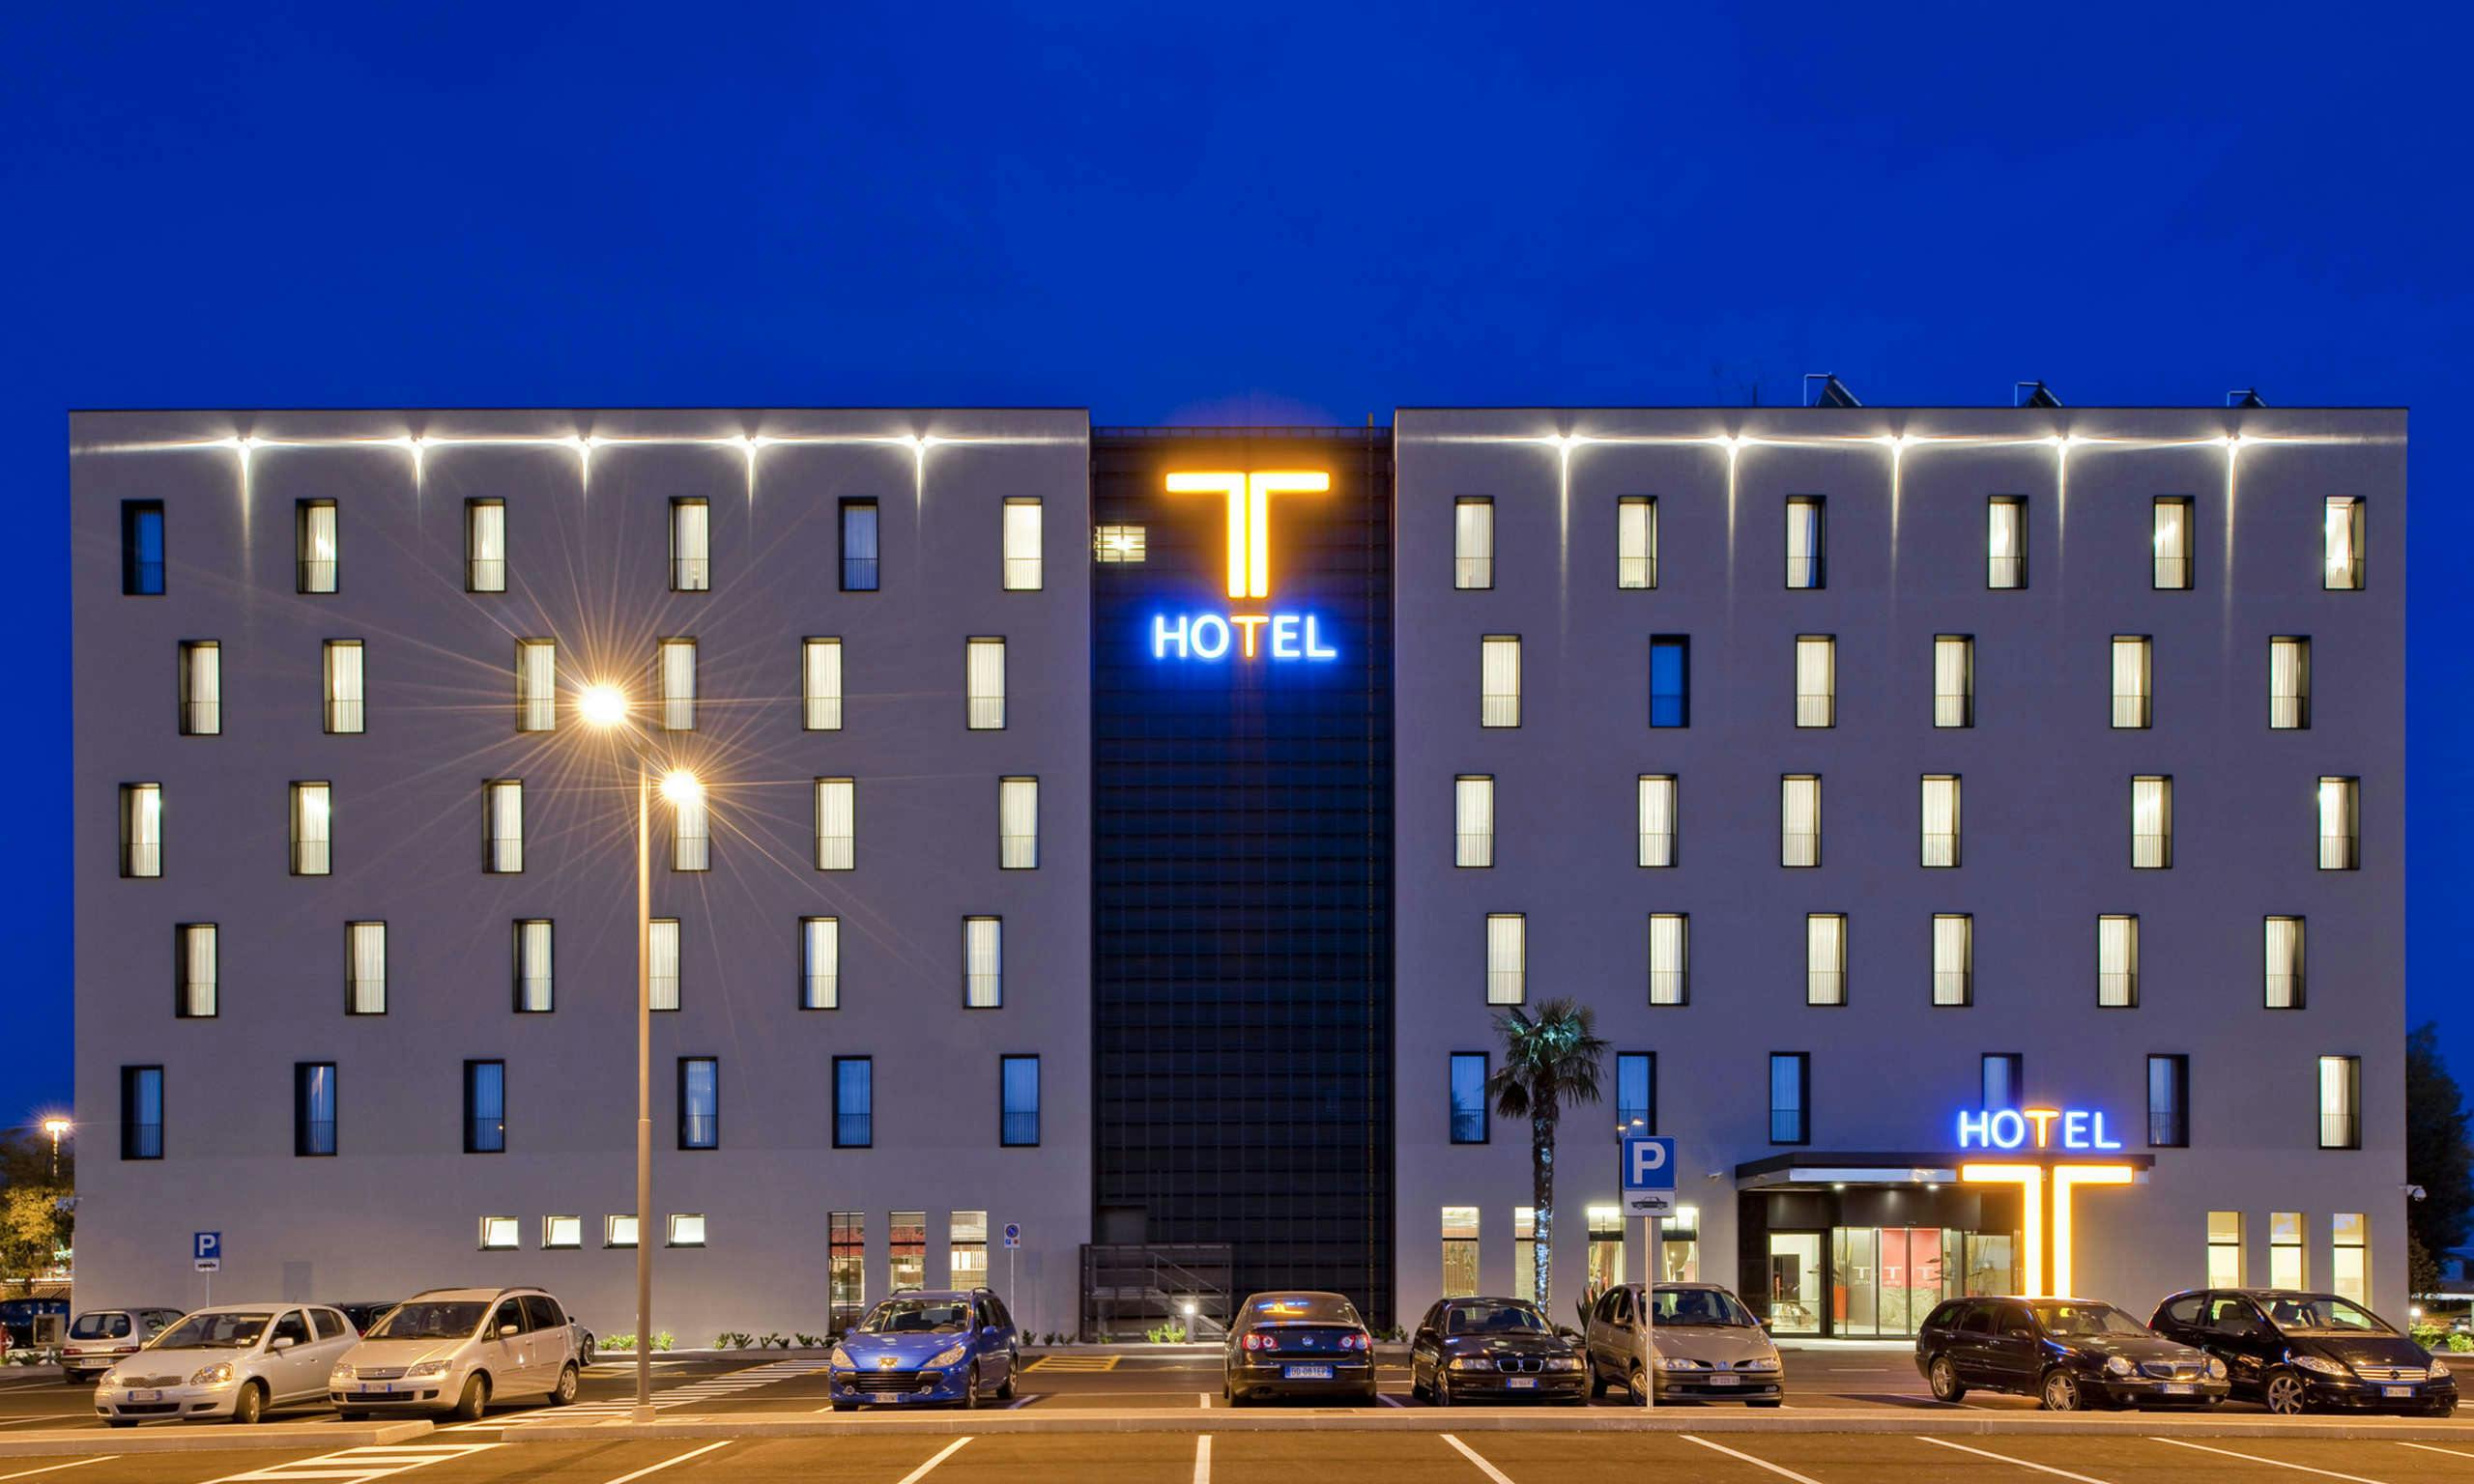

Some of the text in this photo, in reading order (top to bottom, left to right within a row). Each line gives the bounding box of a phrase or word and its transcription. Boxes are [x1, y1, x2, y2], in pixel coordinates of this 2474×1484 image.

[1154, 614, 1338, 658] HOTEL
[1959, 1110, 2121, 1148] HOTEL
[1633, 1141, 1666, 1184] P
[199, 1234, 216, 1256] P
